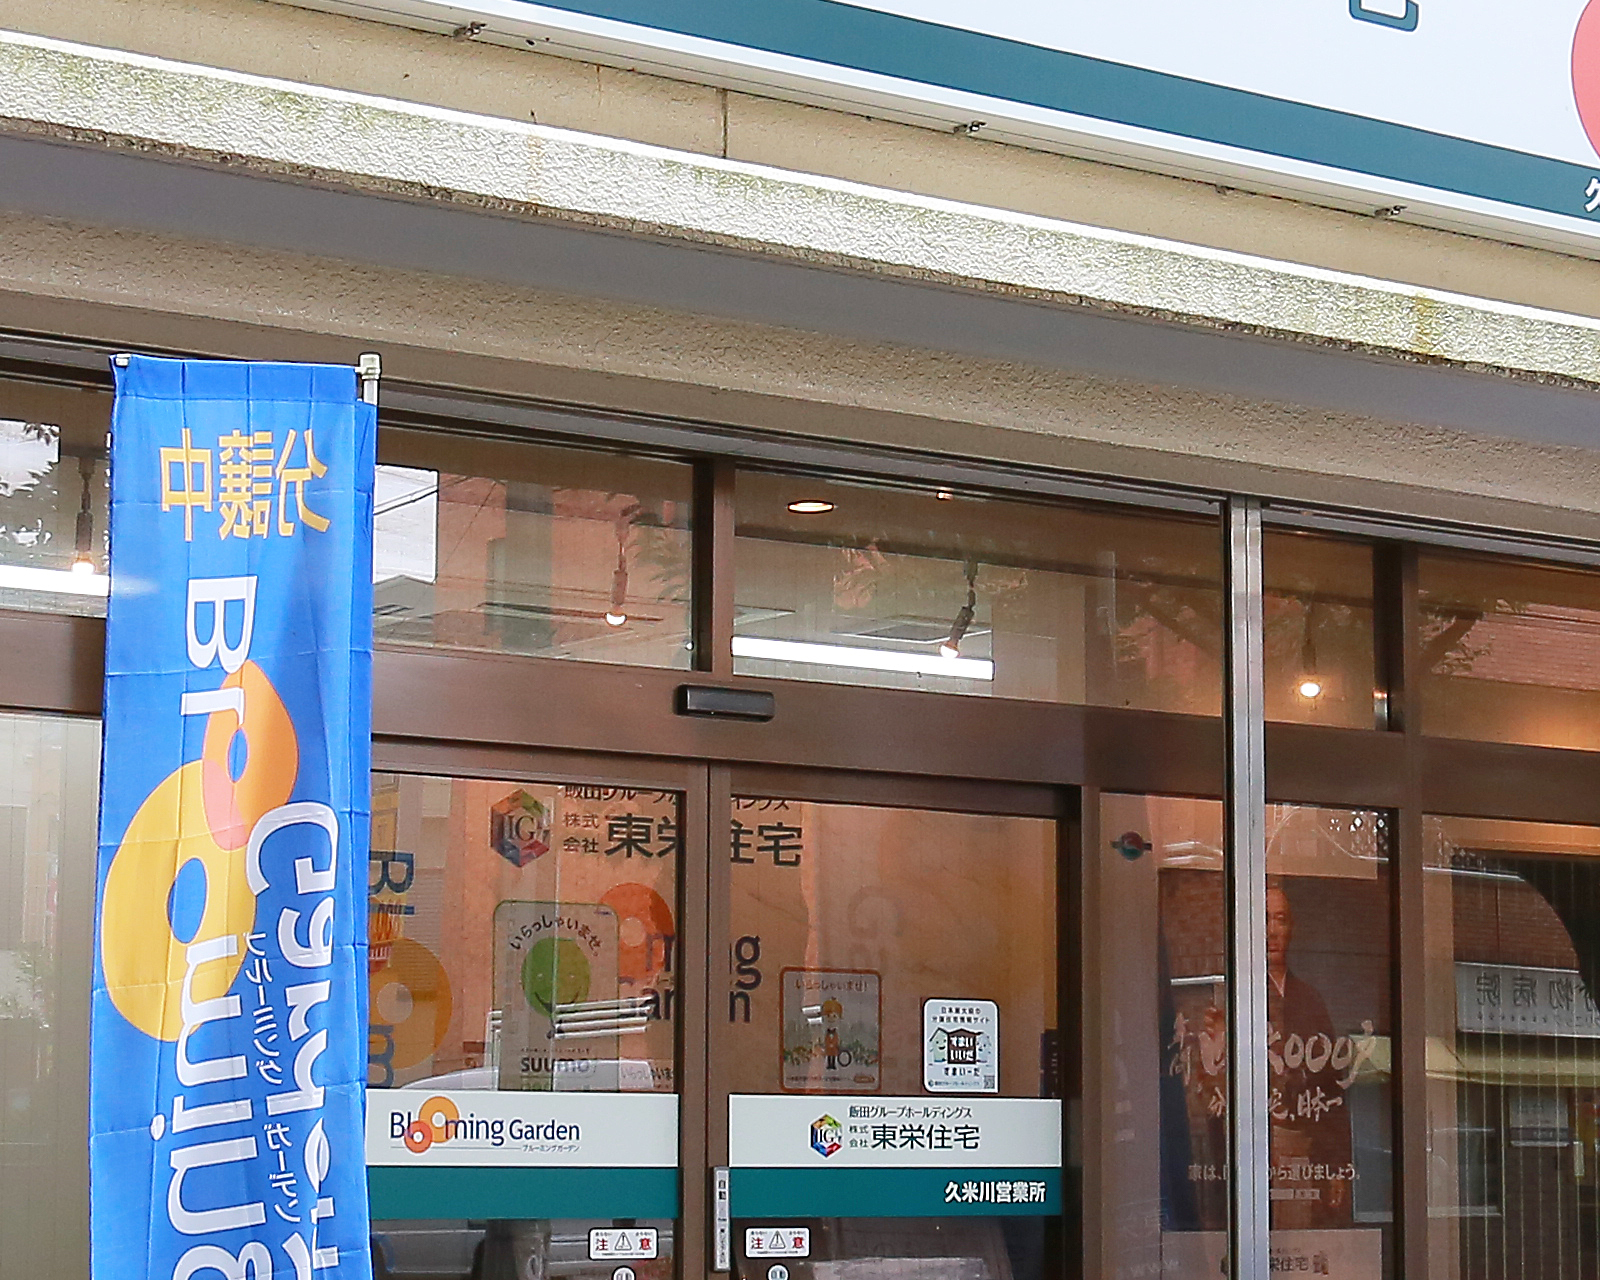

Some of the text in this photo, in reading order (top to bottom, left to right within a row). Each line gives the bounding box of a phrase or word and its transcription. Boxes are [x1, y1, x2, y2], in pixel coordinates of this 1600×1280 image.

[390, 1096, 580, 1153] Blooming Garden
[849, 1106, 973, 1119] 飯田グループホールディングス
[871, 1123, 980, 1150] 東栄住宅
[944, 1180, 1047, 1204] 久米川営業所
[1268, 1256, 1309, 1272] 栄住宅
